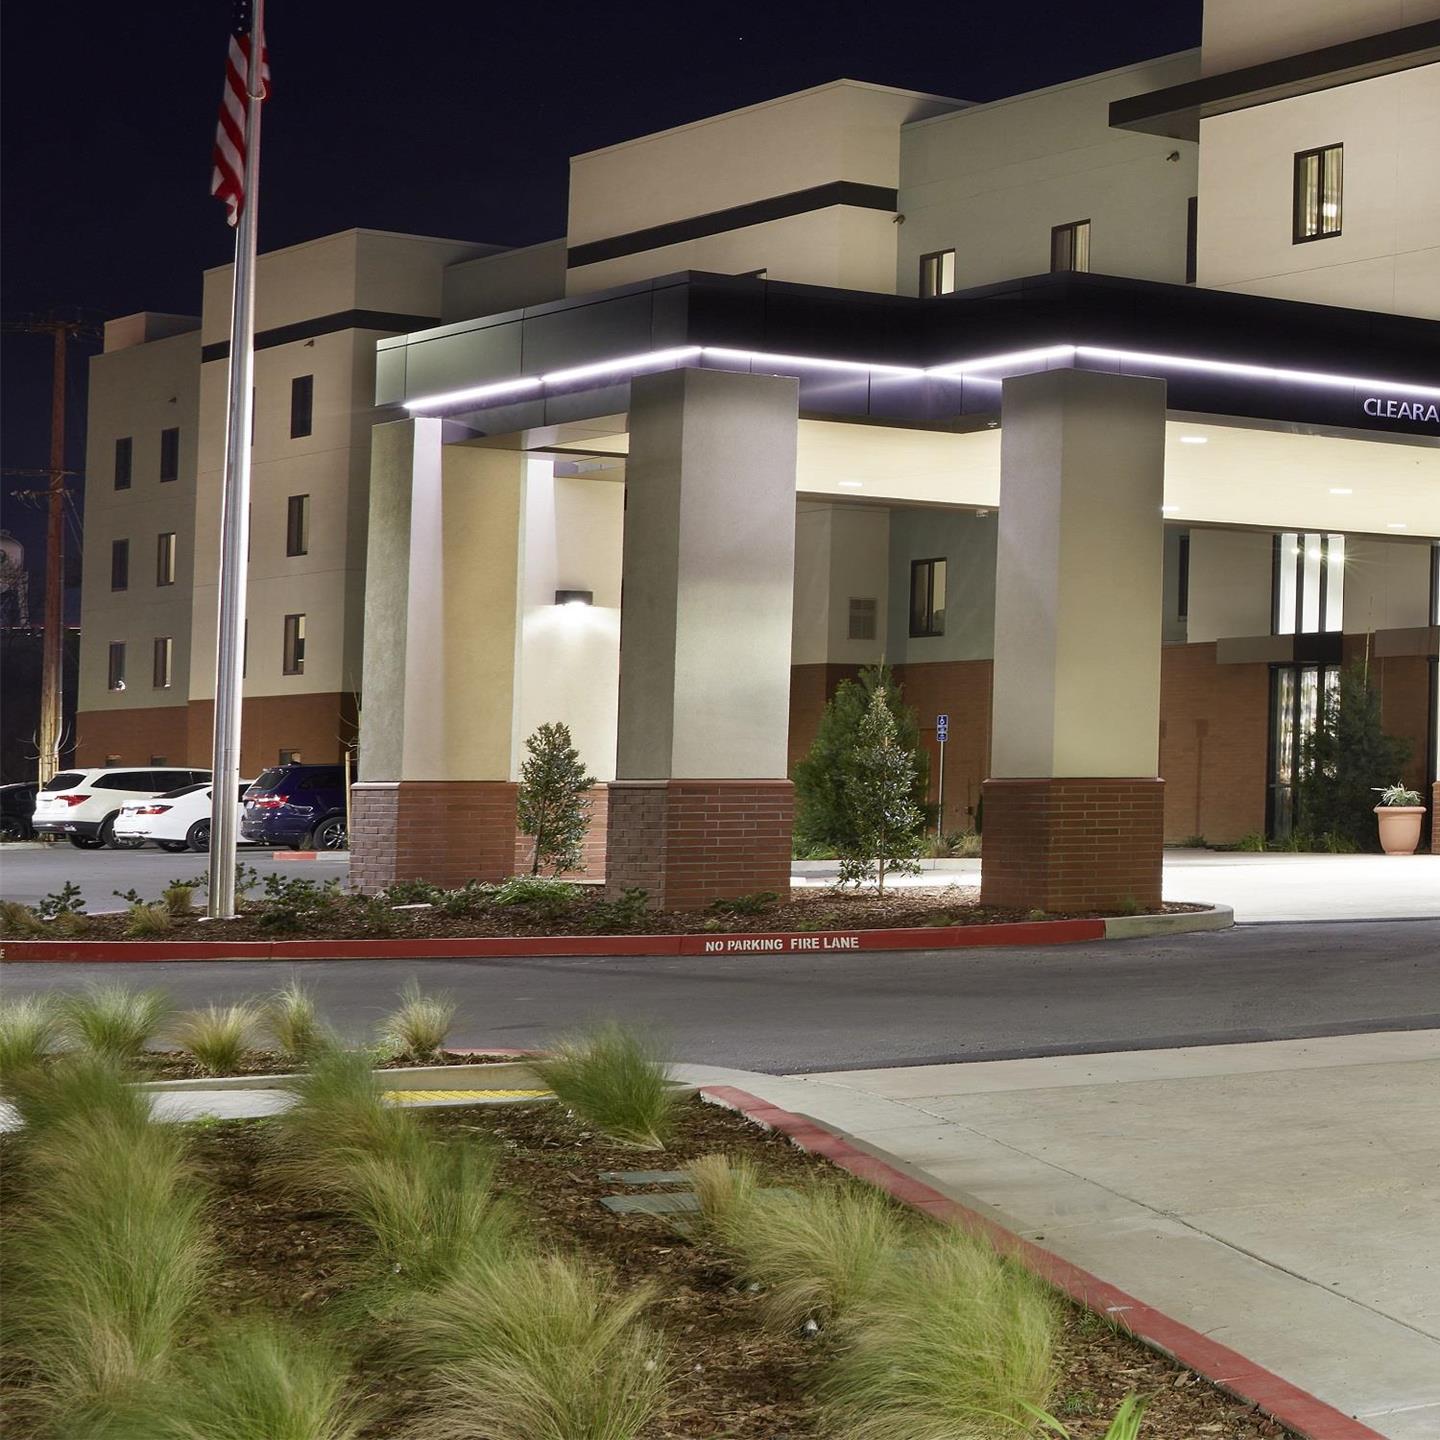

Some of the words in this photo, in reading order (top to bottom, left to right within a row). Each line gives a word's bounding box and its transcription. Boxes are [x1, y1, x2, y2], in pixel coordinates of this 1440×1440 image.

[705, 941, 724, 952] NO
[727, 939, 783, 951] PARKING
[790, 938, 820, 949] FIRE
[823, 937, 860, 949] LANE
